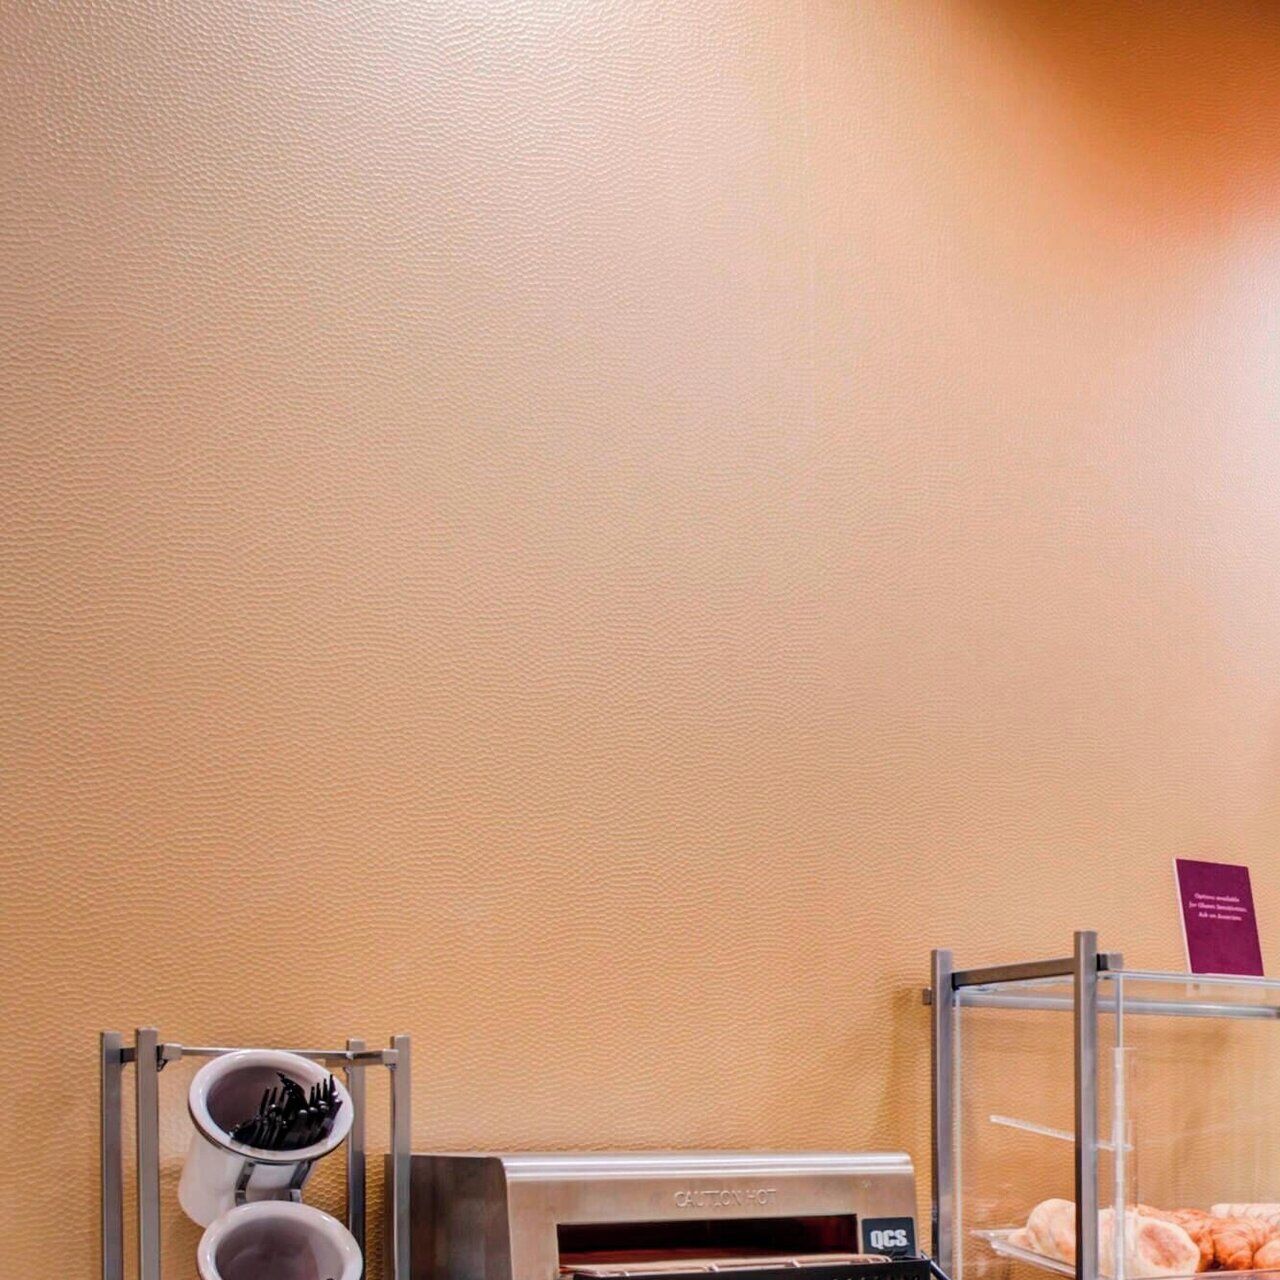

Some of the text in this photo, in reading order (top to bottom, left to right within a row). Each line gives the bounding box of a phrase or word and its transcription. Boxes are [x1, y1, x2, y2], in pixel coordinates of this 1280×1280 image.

[674, 1188, 777, 1207] CAUTION HOT
[870, 1229, 908, 1250] QCS
